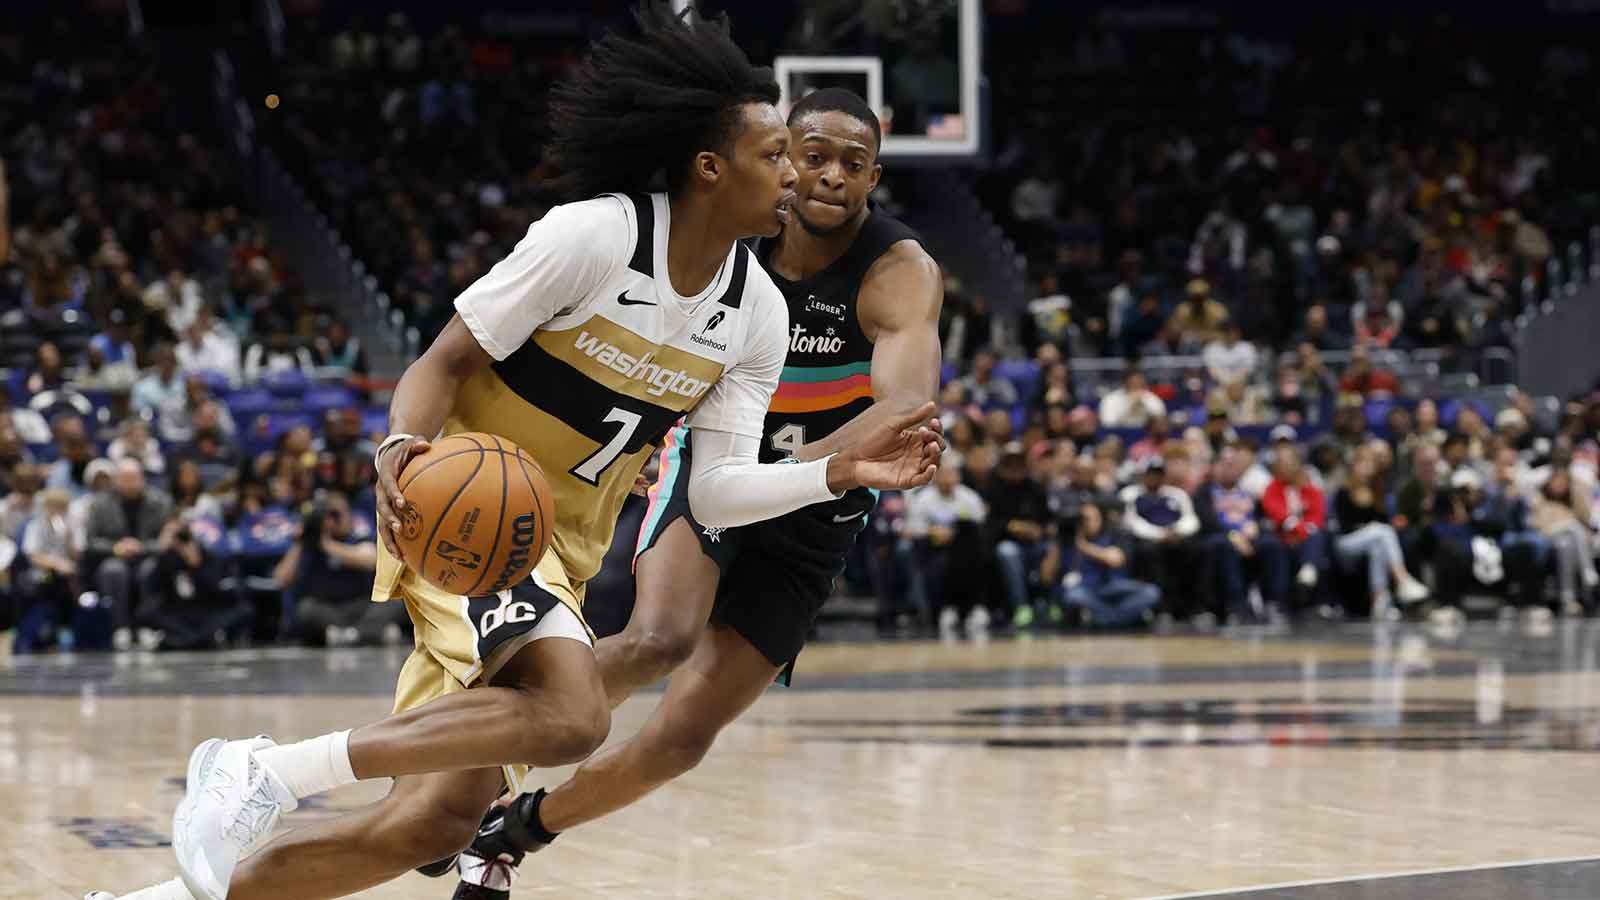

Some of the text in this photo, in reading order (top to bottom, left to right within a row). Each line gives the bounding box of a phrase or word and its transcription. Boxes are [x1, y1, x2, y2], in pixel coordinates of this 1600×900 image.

[810, 299, 842, 316] LEDGER
[690, 333, 727, 352] Robinhood
[787, 323, 846, 353] tonio
[570, 405, 643, 485] 7
[769, 422, 806, 456] 4
